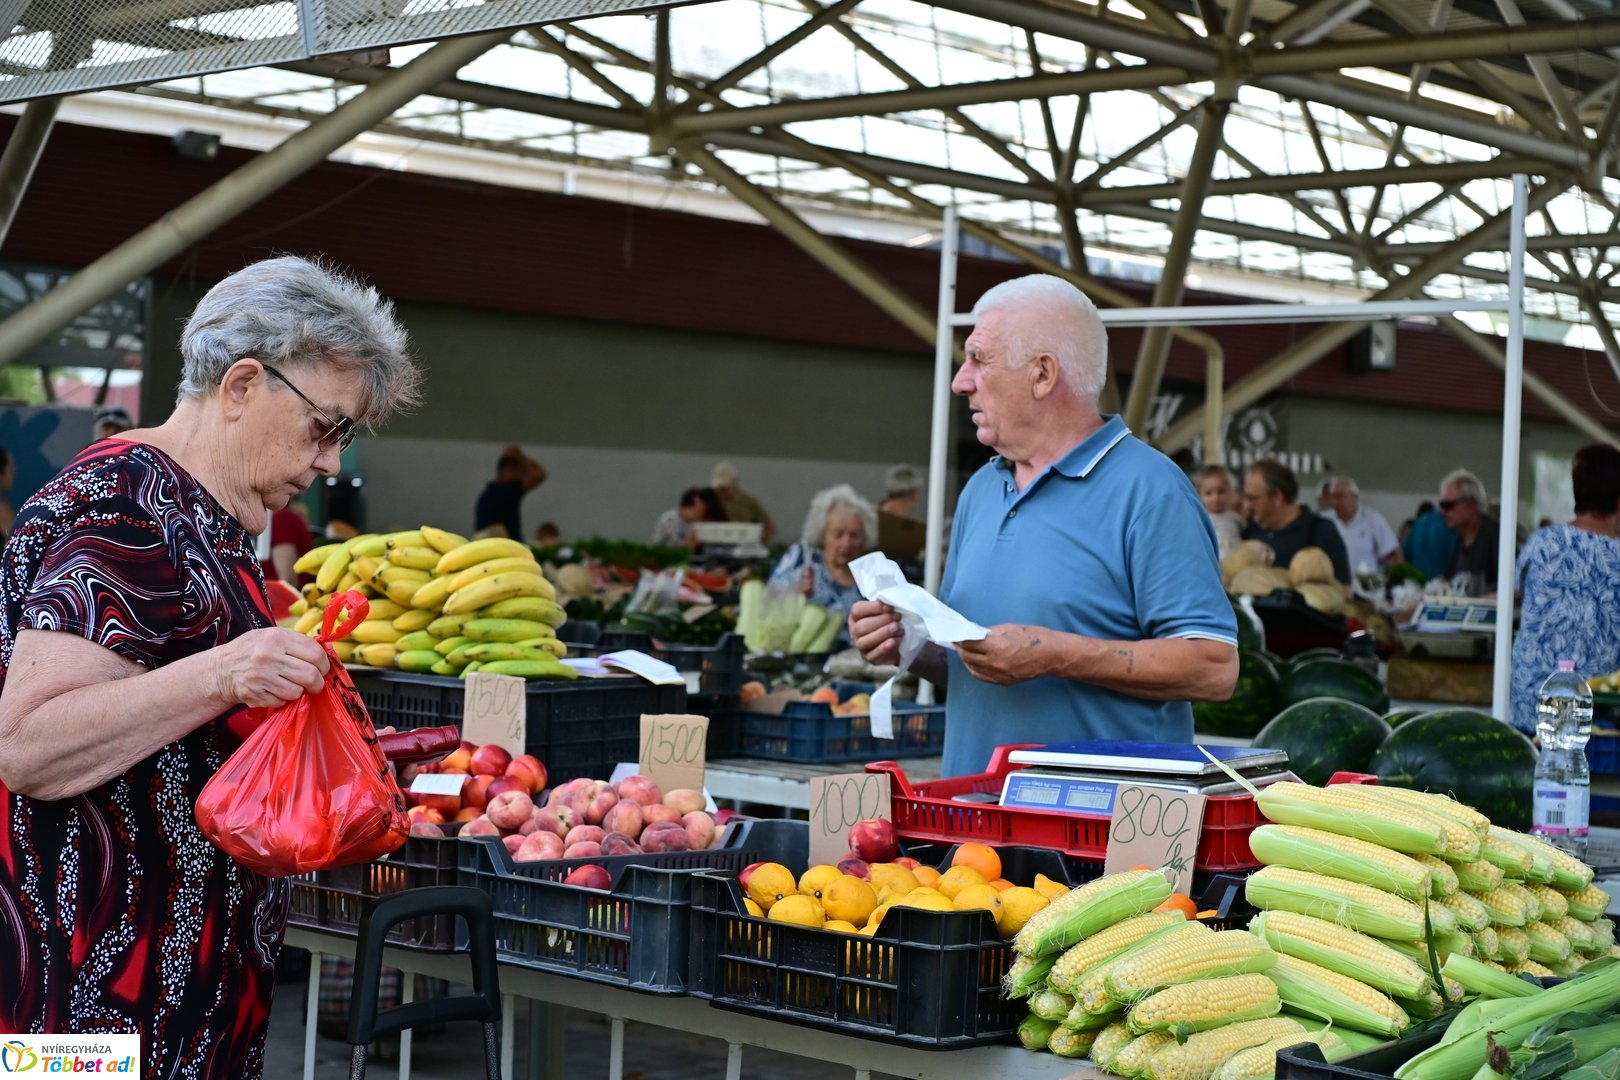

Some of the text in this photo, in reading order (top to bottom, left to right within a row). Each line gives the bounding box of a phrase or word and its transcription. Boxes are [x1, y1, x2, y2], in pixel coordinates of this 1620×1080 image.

[641, 719, 705, 774] 1500
[812, 774, 880, 837] 1000
[1112, 786, 1189, 844] 800
